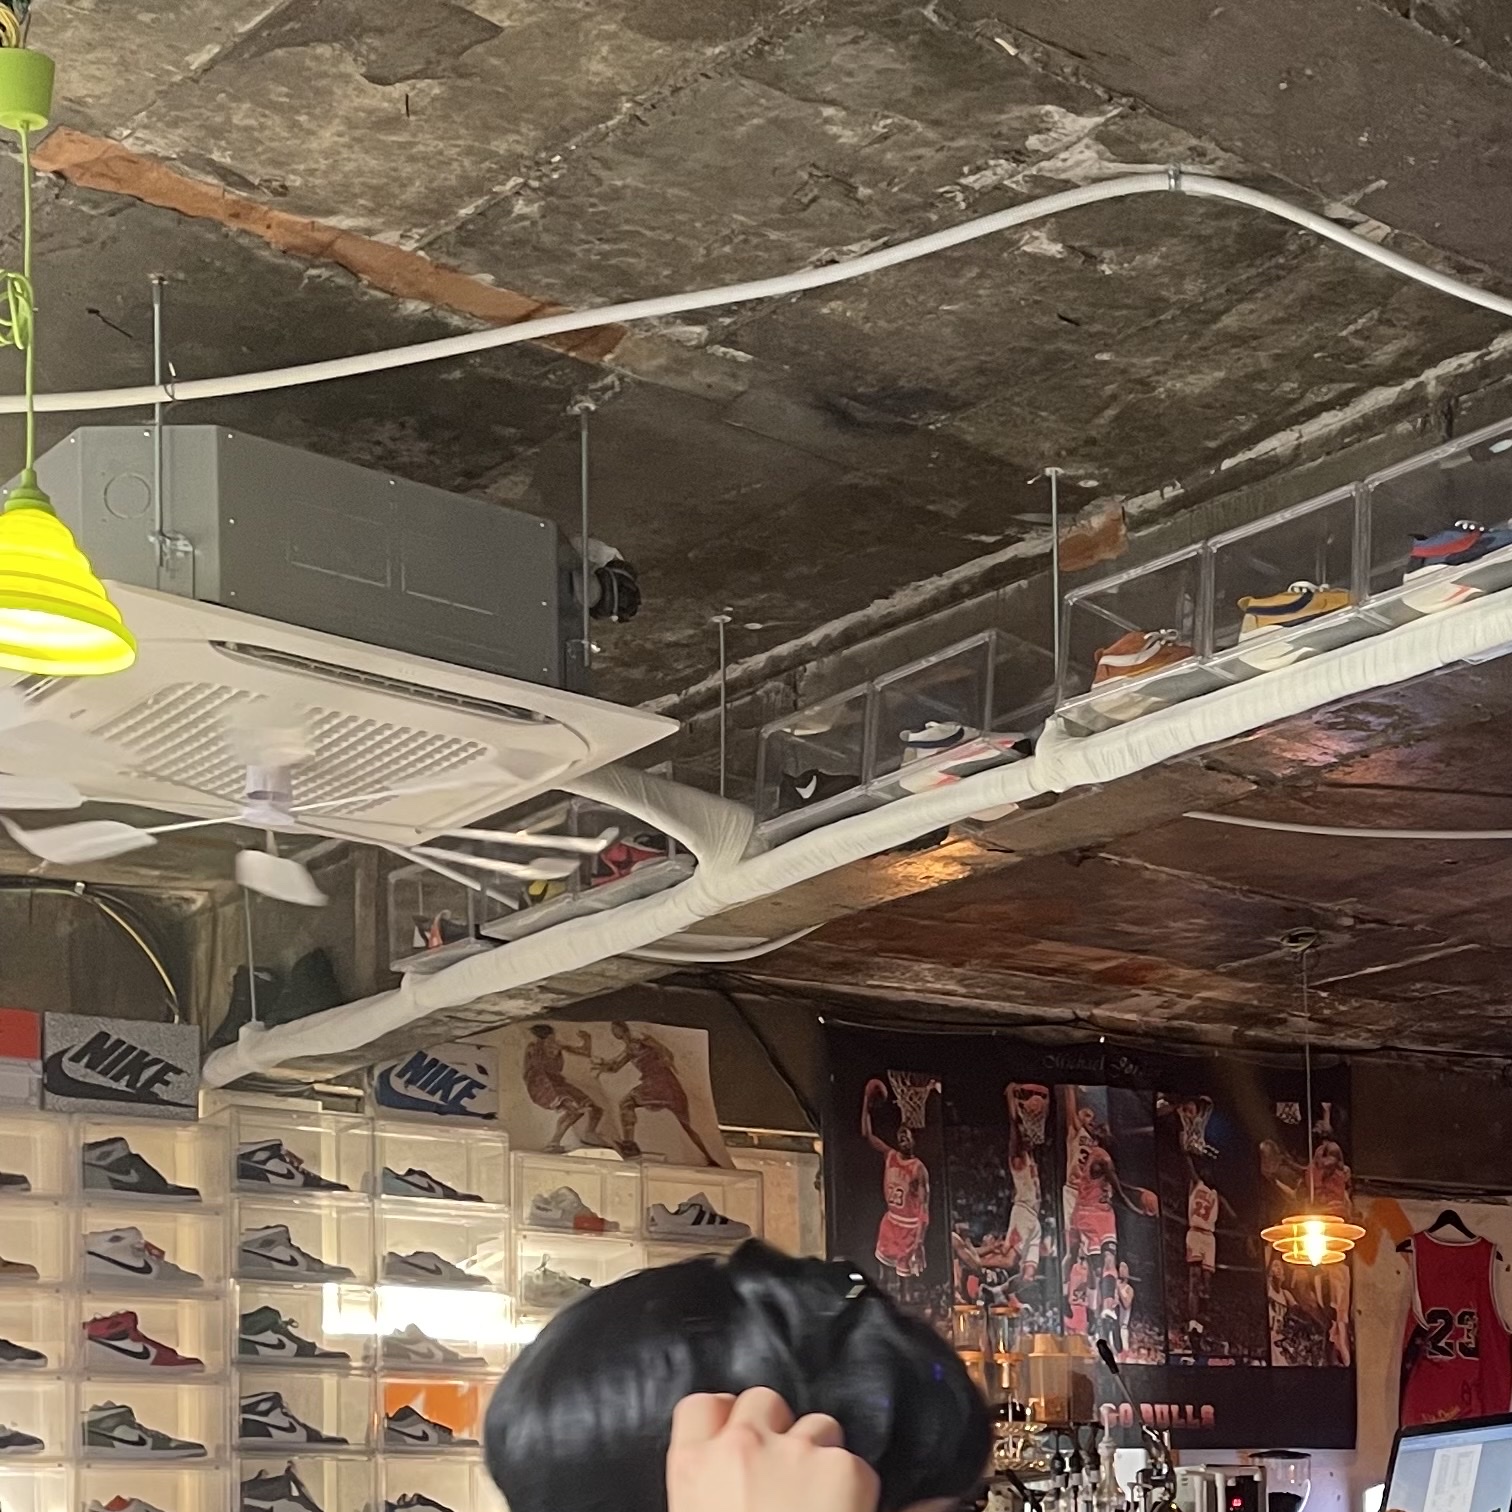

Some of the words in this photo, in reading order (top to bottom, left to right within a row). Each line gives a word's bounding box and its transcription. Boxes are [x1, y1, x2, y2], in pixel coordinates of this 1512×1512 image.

[69, 1031, 187, 1096] NIKE
[395, 1051, 488, 1106] NIKE
[1424, 1307, 1480, 1361] 23
